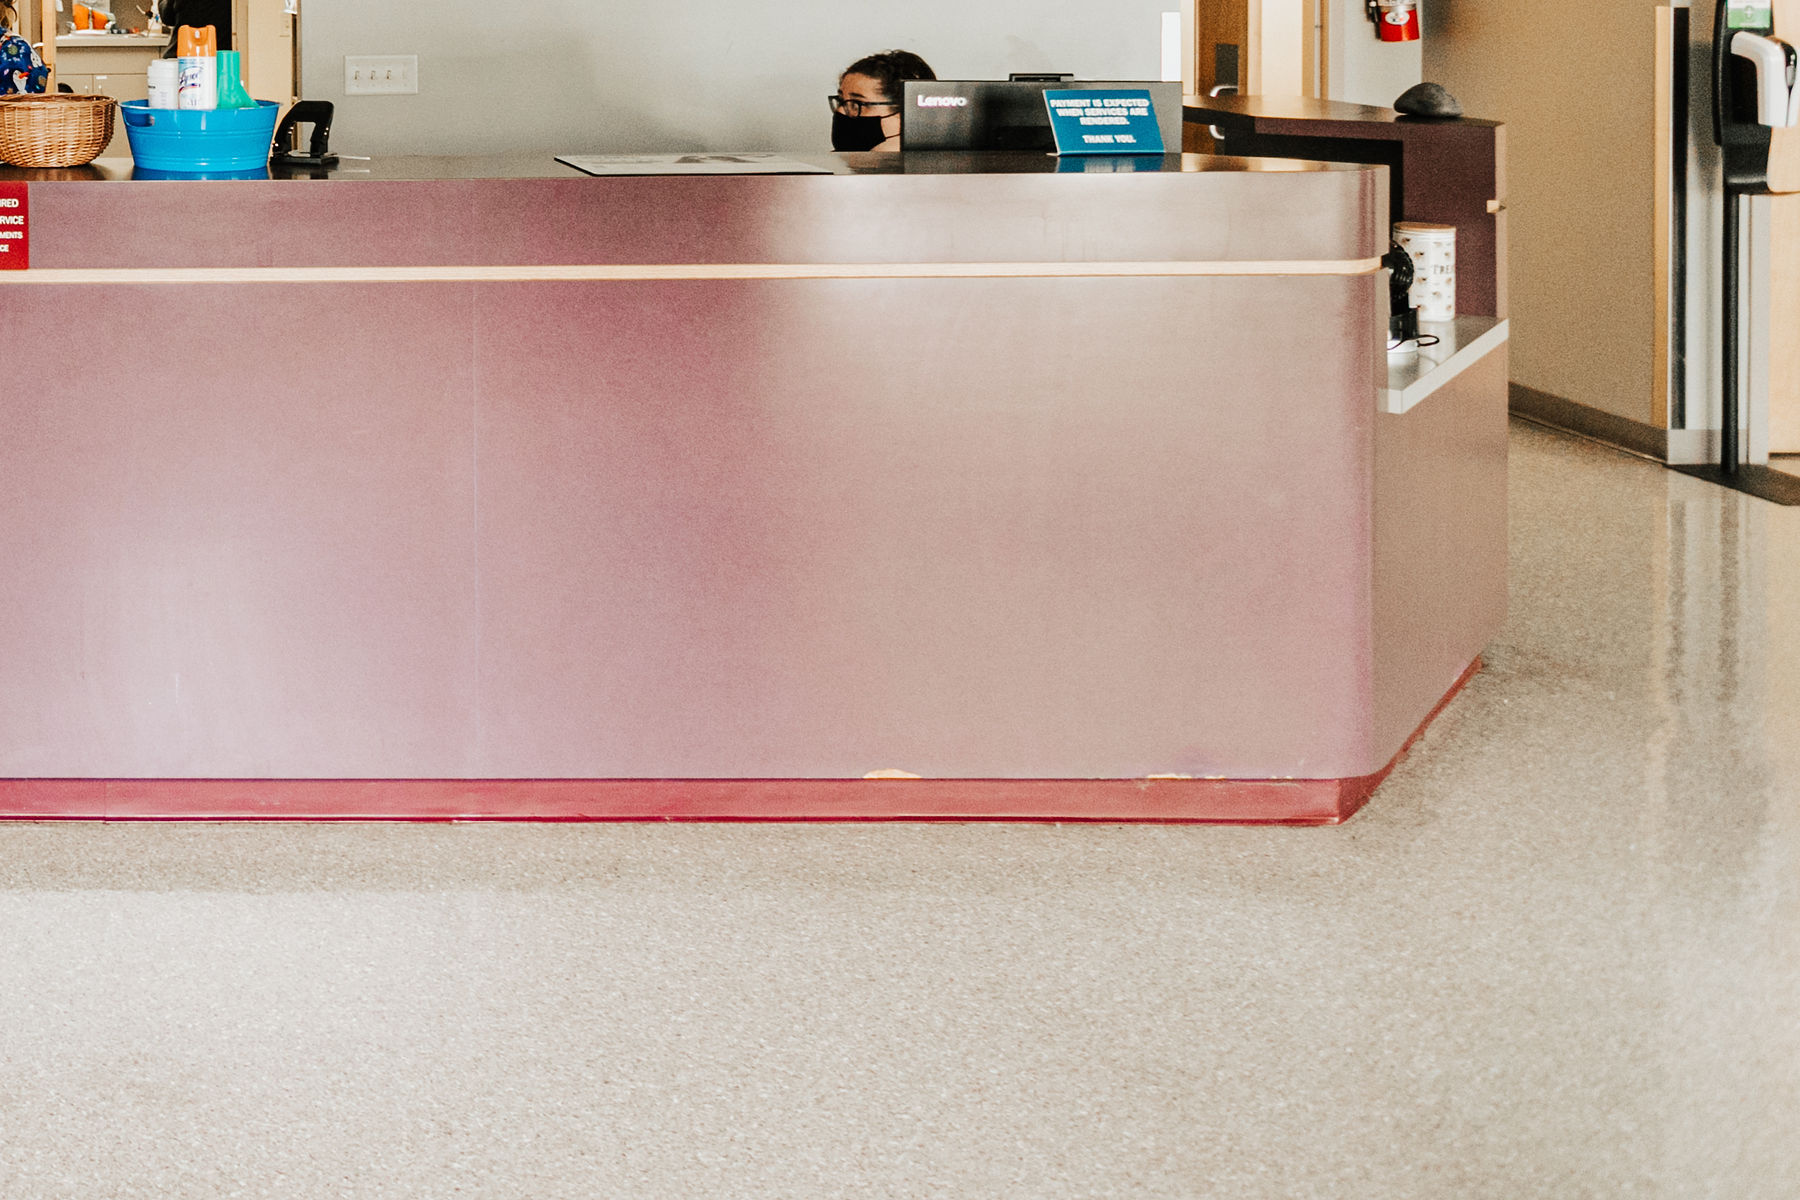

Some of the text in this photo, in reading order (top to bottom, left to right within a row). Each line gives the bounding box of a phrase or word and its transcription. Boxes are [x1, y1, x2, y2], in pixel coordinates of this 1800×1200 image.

[917, 94, 968, 107] Lenovo
[1049, 98, 1150, 108] PAYMENT IS EXPECTED
[1056, 107, 1149, 116] WHEN SERVICES ARE
[1082, 134, 1137, 143] THANK YOU.
